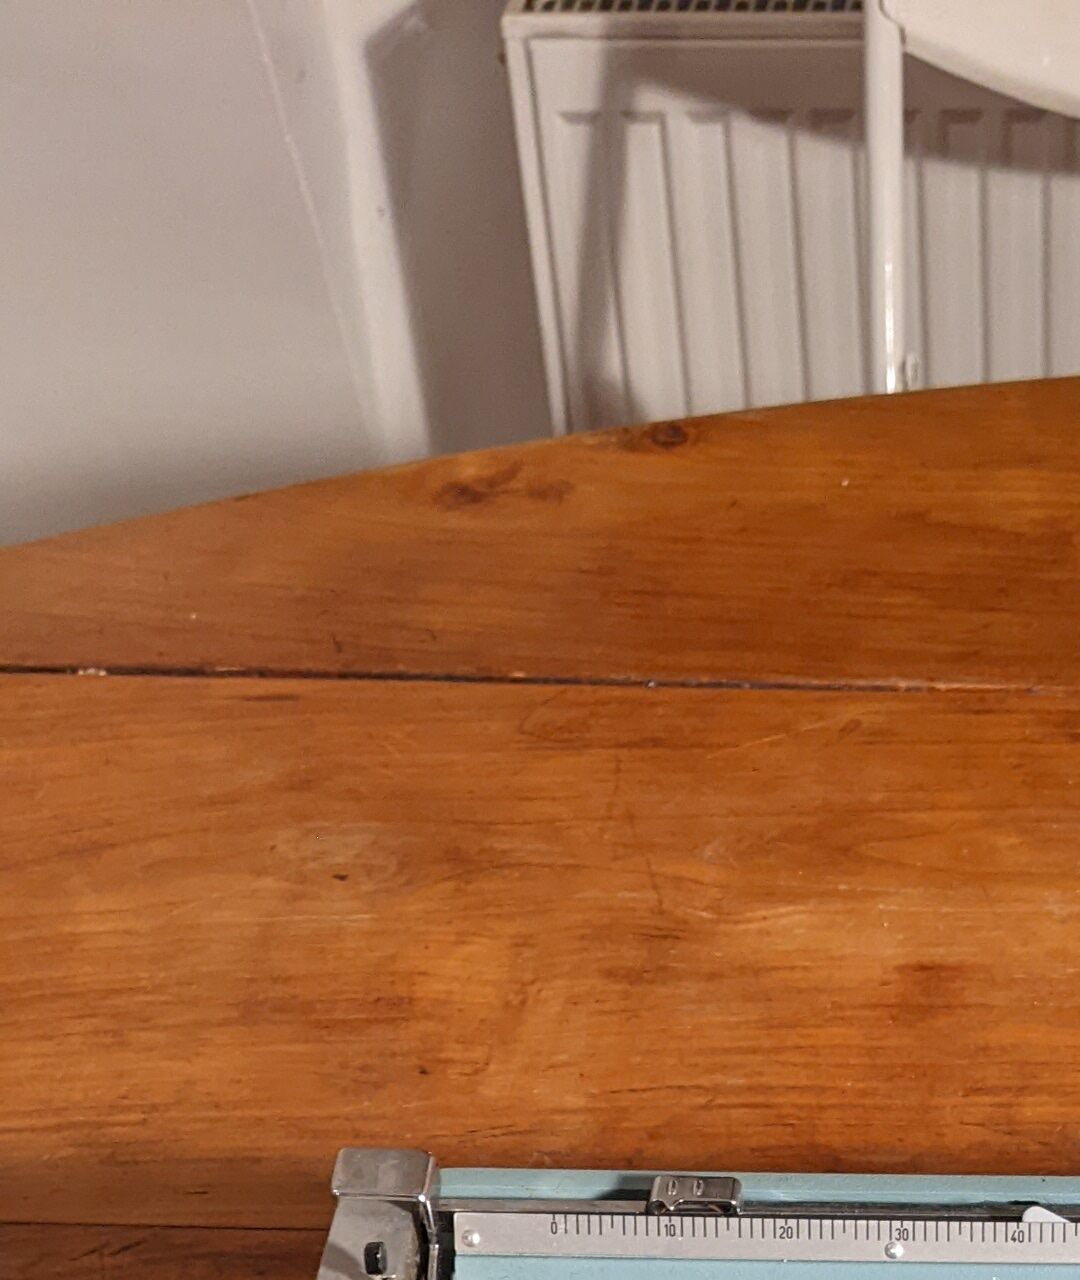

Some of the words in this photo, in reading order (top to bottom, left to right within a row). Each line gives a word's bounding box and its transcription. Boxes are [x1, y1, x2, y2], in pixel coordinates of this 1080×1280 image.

[550, 1221, 558, 1235] 0
[664, 1223, 676, 1238] 10
[778, 1225, 794, 1240] 20
[895, 1228, 910, 1242] 30
[1010, 1229, 1025, 1244] 40
